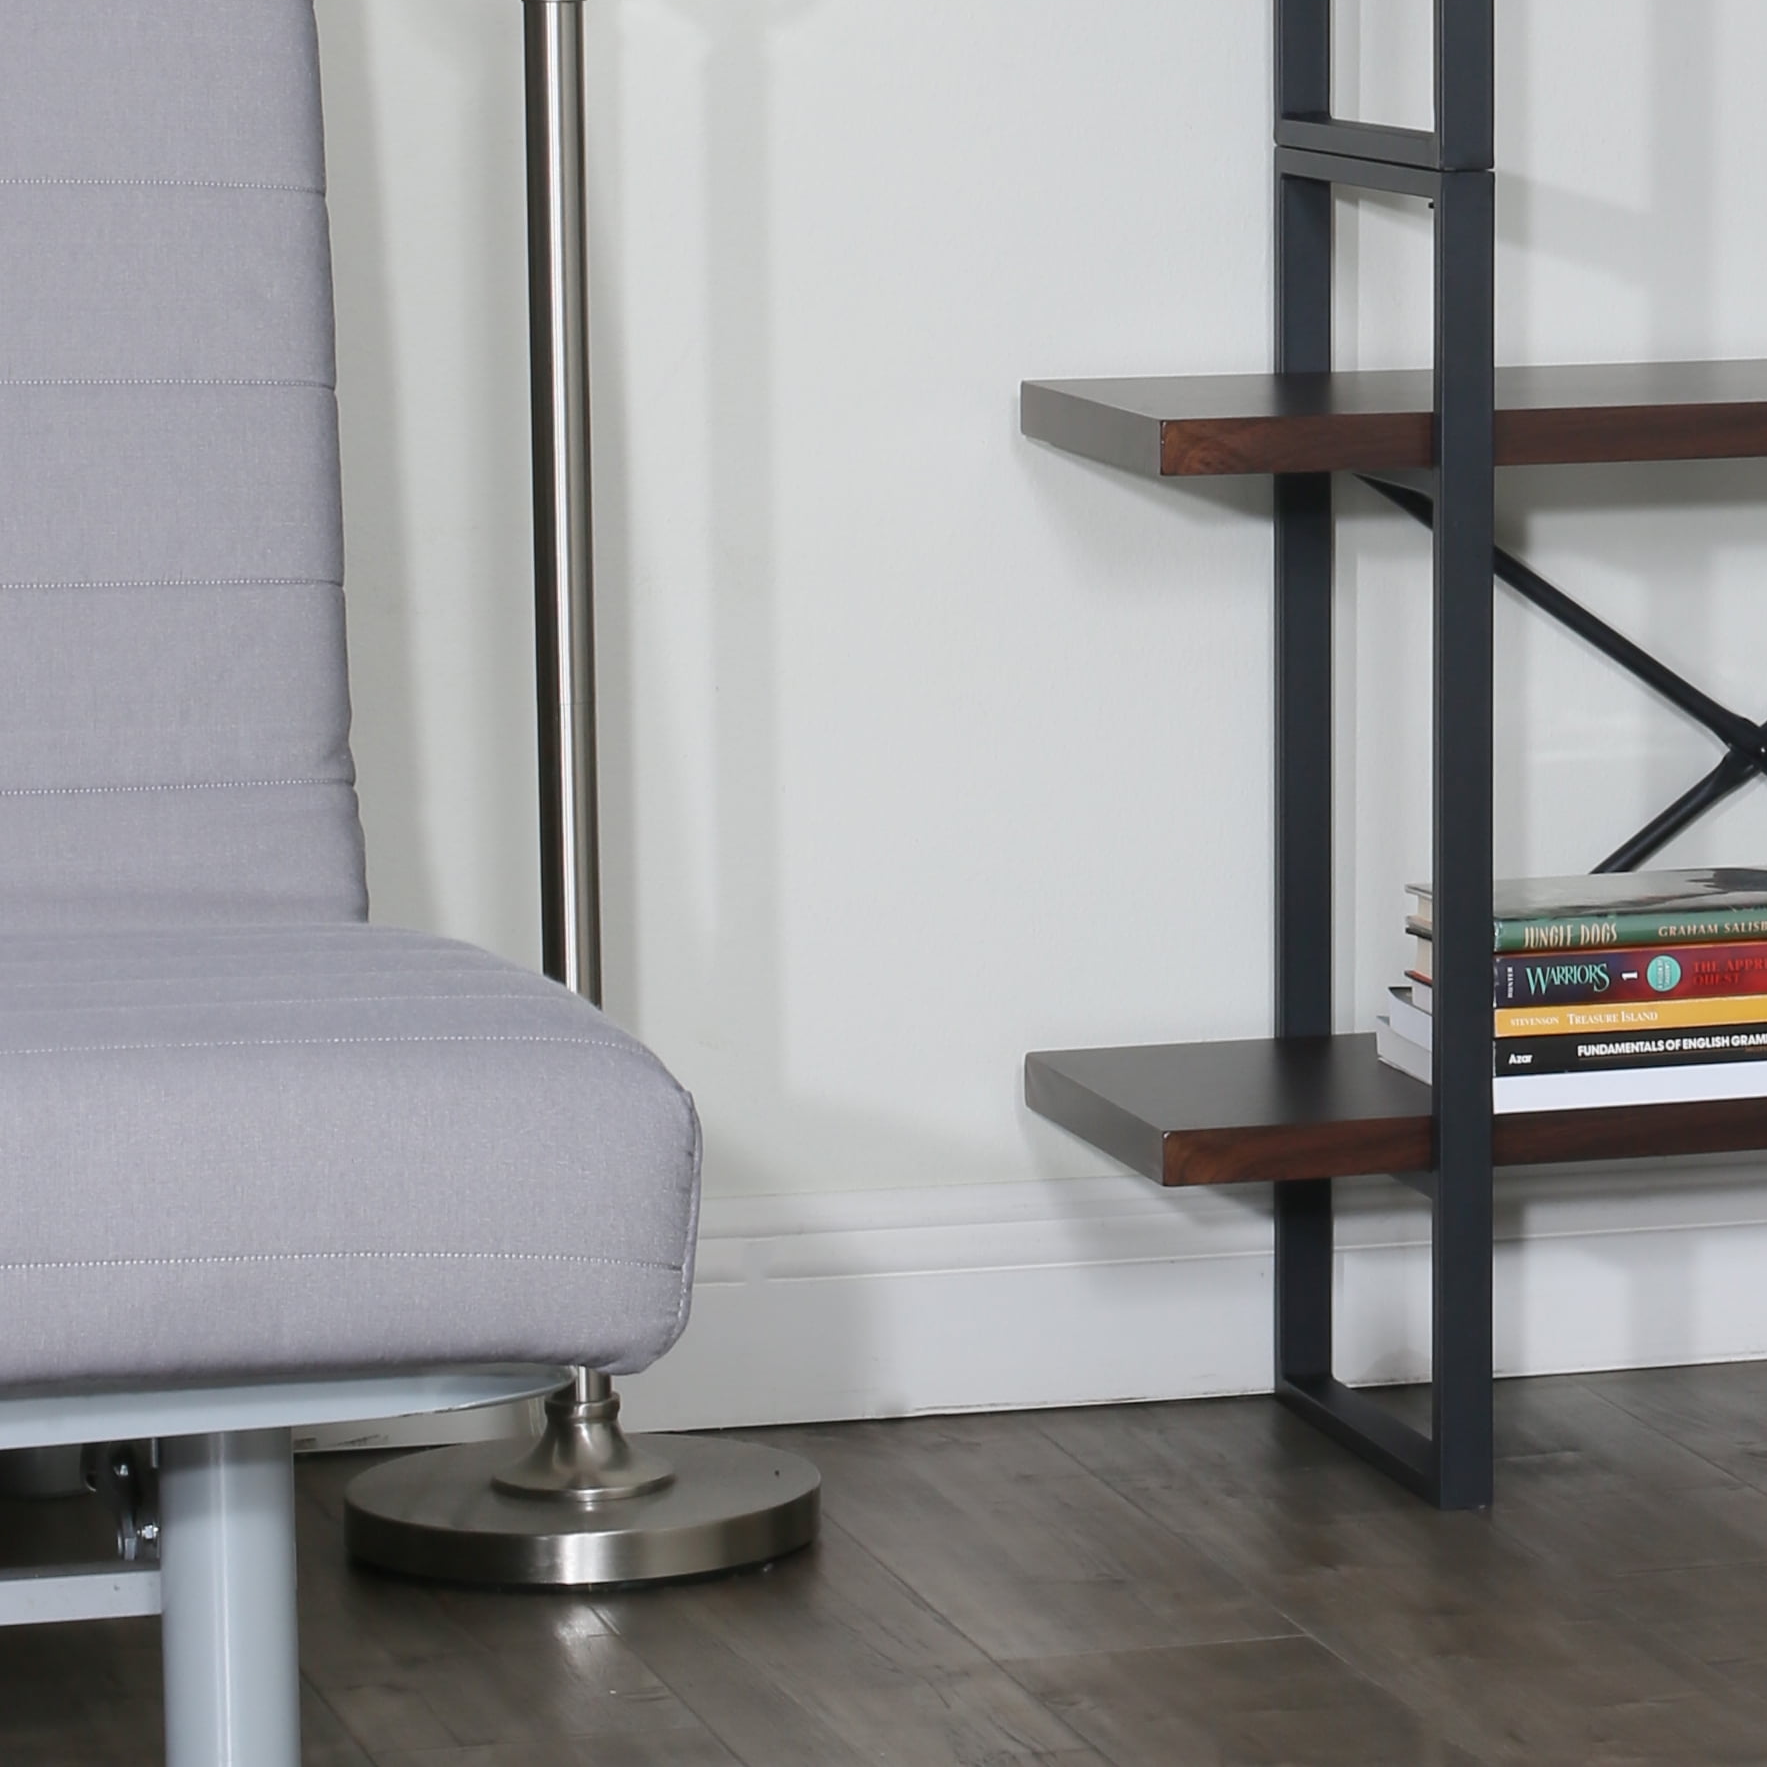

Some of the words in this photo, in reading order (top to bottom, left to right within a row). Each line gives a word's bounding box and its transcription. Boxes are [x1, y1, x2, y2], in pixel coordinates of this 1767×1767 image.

[1524, 924, 1574, 949] JUNGLE
[1579, 922, 1618, 946] DOGS
[1658, 923, 1718, 938] GRAHAM
[1693, 960, 1718, 973] THE
[1525, 963, 1610, 996] WARRIORS
[1693, 973, 1740, 986] QUEST
[1510, 1016, 1559, 1026] STEVENSON
[1567, 1012, 1619, 1026] TREASURE
[1621, 1010, 1659, 1023] ISLAND
[1577, 1040, 1664, 1057] FUNDAMENTALS
[1665, 1038, 1682, 1051] OF
[1682, 1036, 1730, 1050] ENGLISH
[1508, 1053, 1533, 1065] Azar
